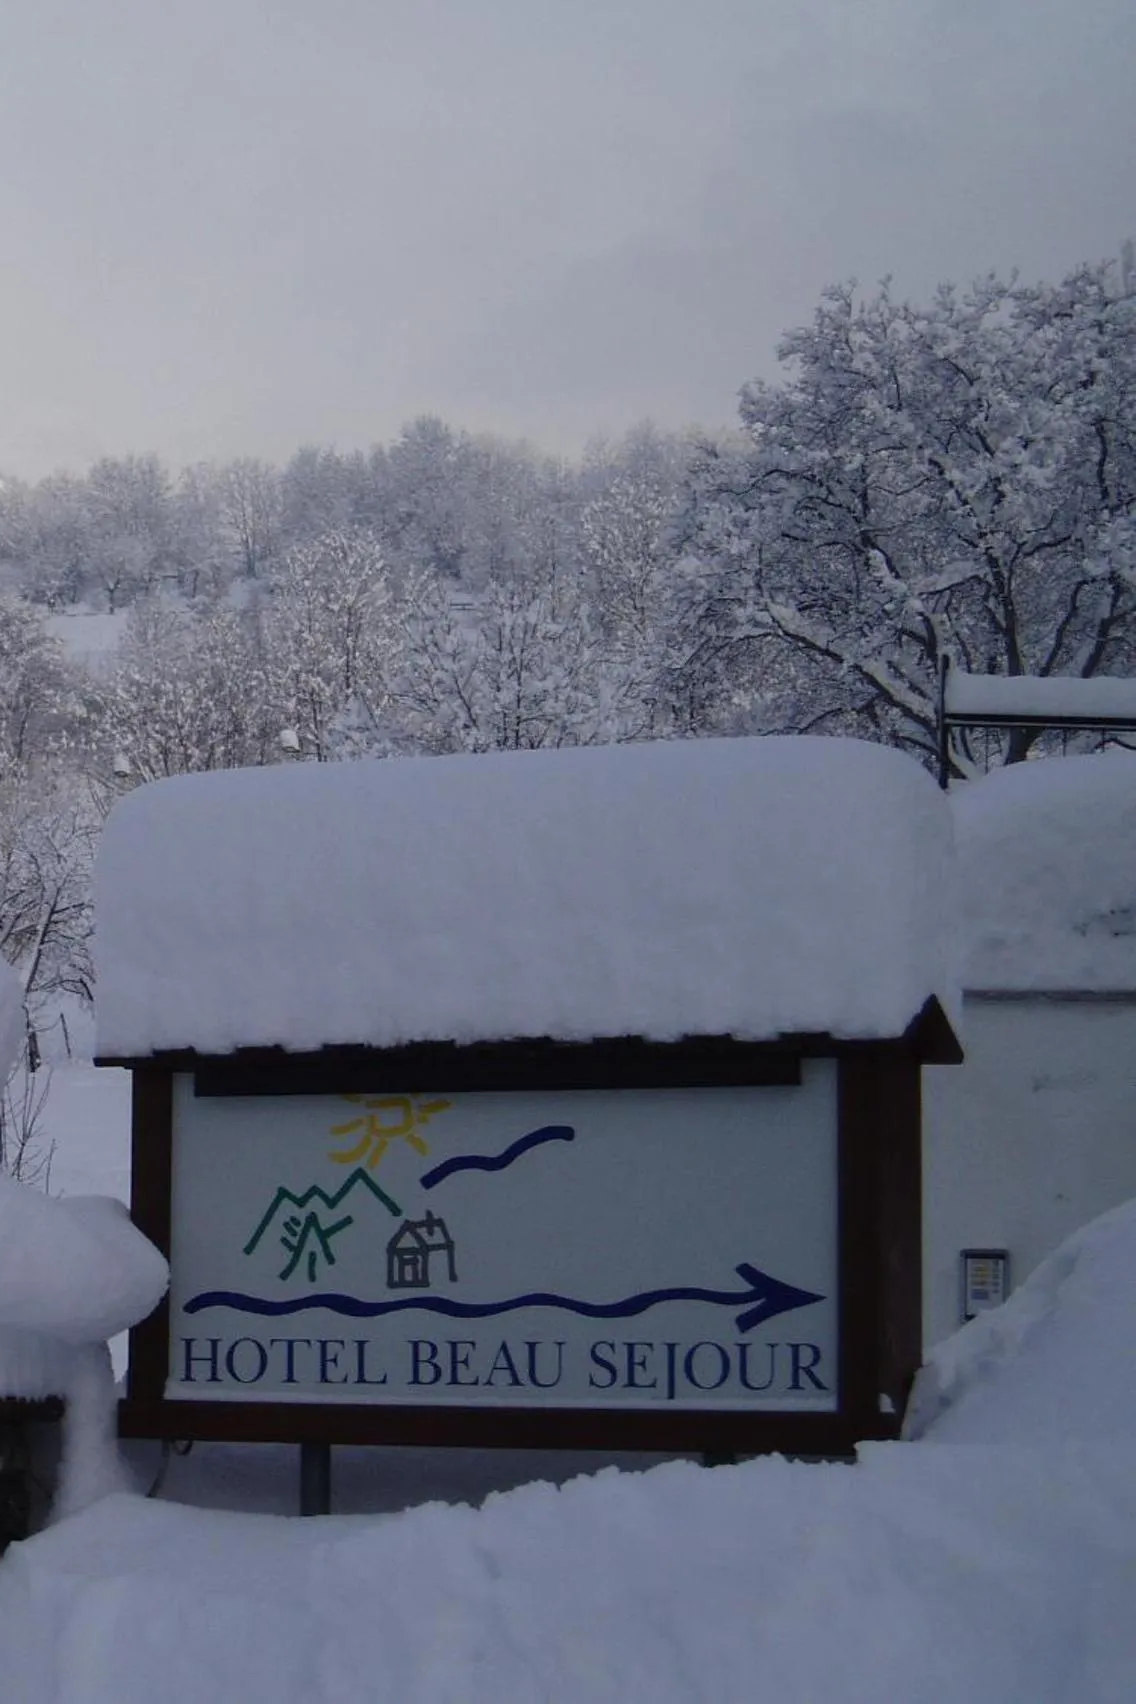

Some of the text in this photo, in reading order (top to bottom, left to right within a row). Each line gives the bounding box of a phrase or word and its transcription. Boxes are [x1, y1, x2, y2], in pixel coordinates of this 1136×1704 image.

[180, 1337, 830, 1399] HOTEL BEAU SEJOUR
